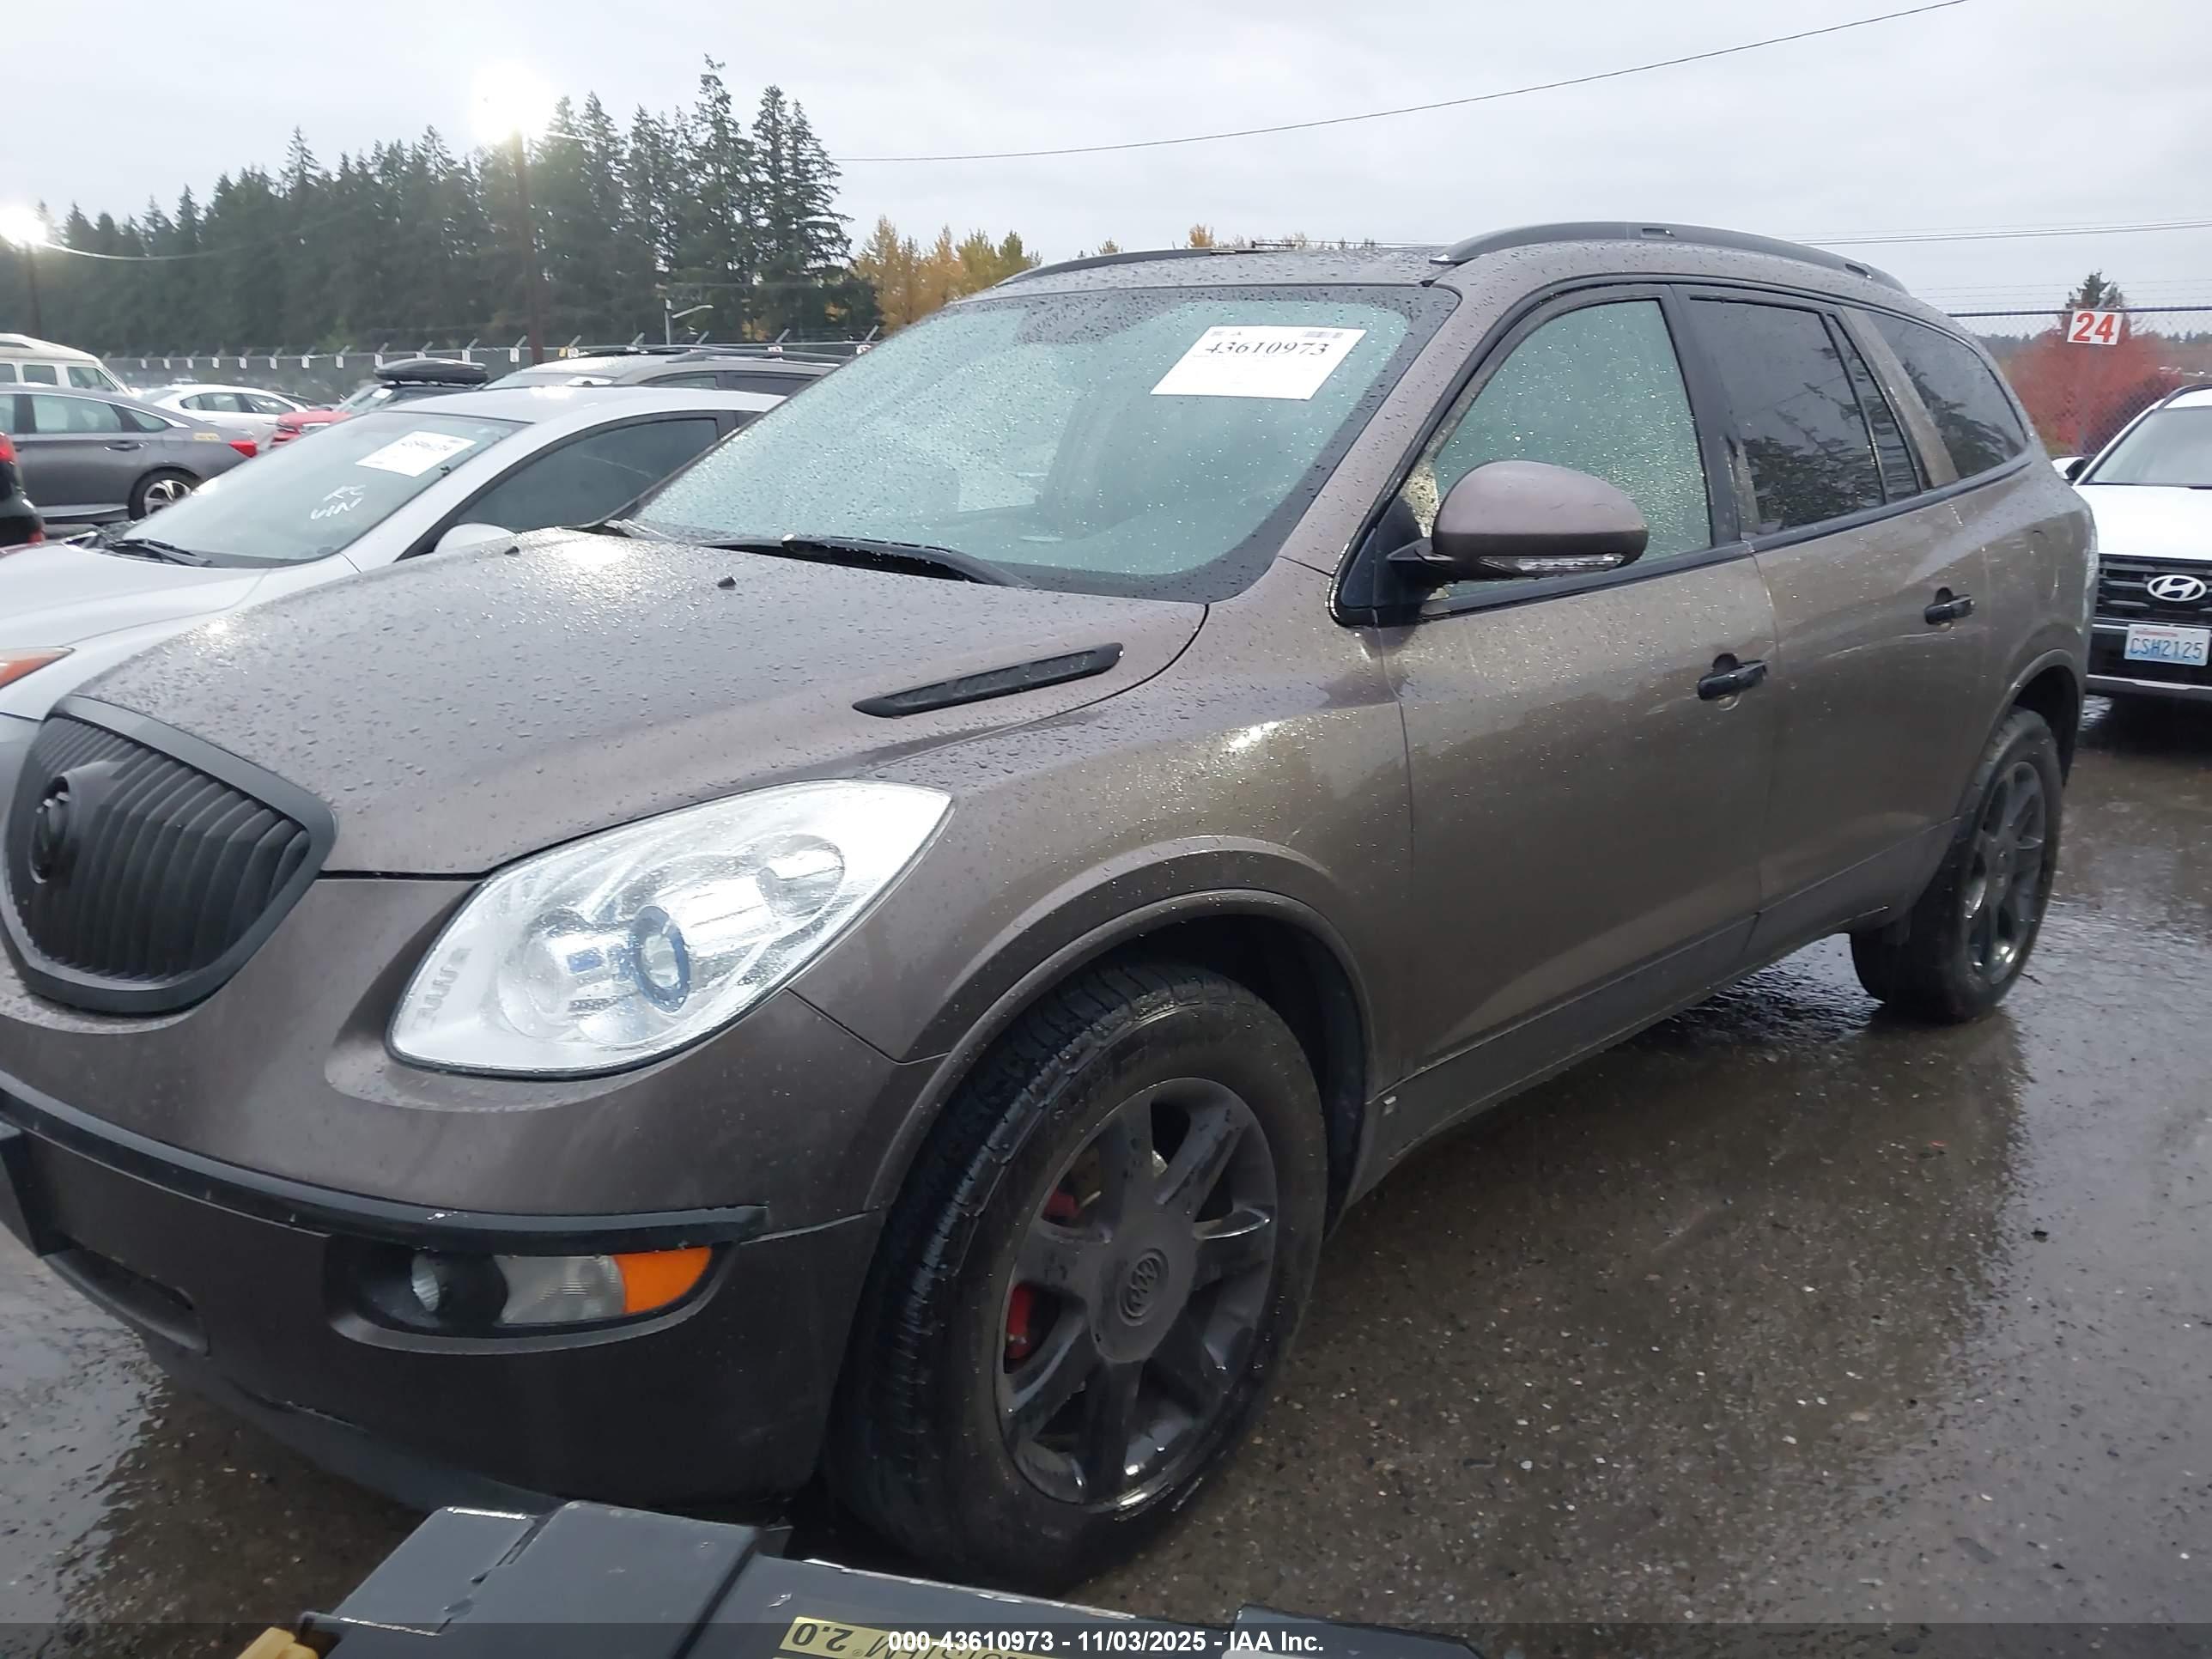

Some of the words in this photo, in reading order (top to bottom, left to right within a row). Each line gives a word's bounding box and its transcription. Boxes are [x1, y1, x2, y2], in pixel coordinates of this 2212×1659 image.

[2074, 313, 2115, 343] 24
[1206, 342, 1329, 355] 43610973
[792, 1622, 854, 1652] 2.0
